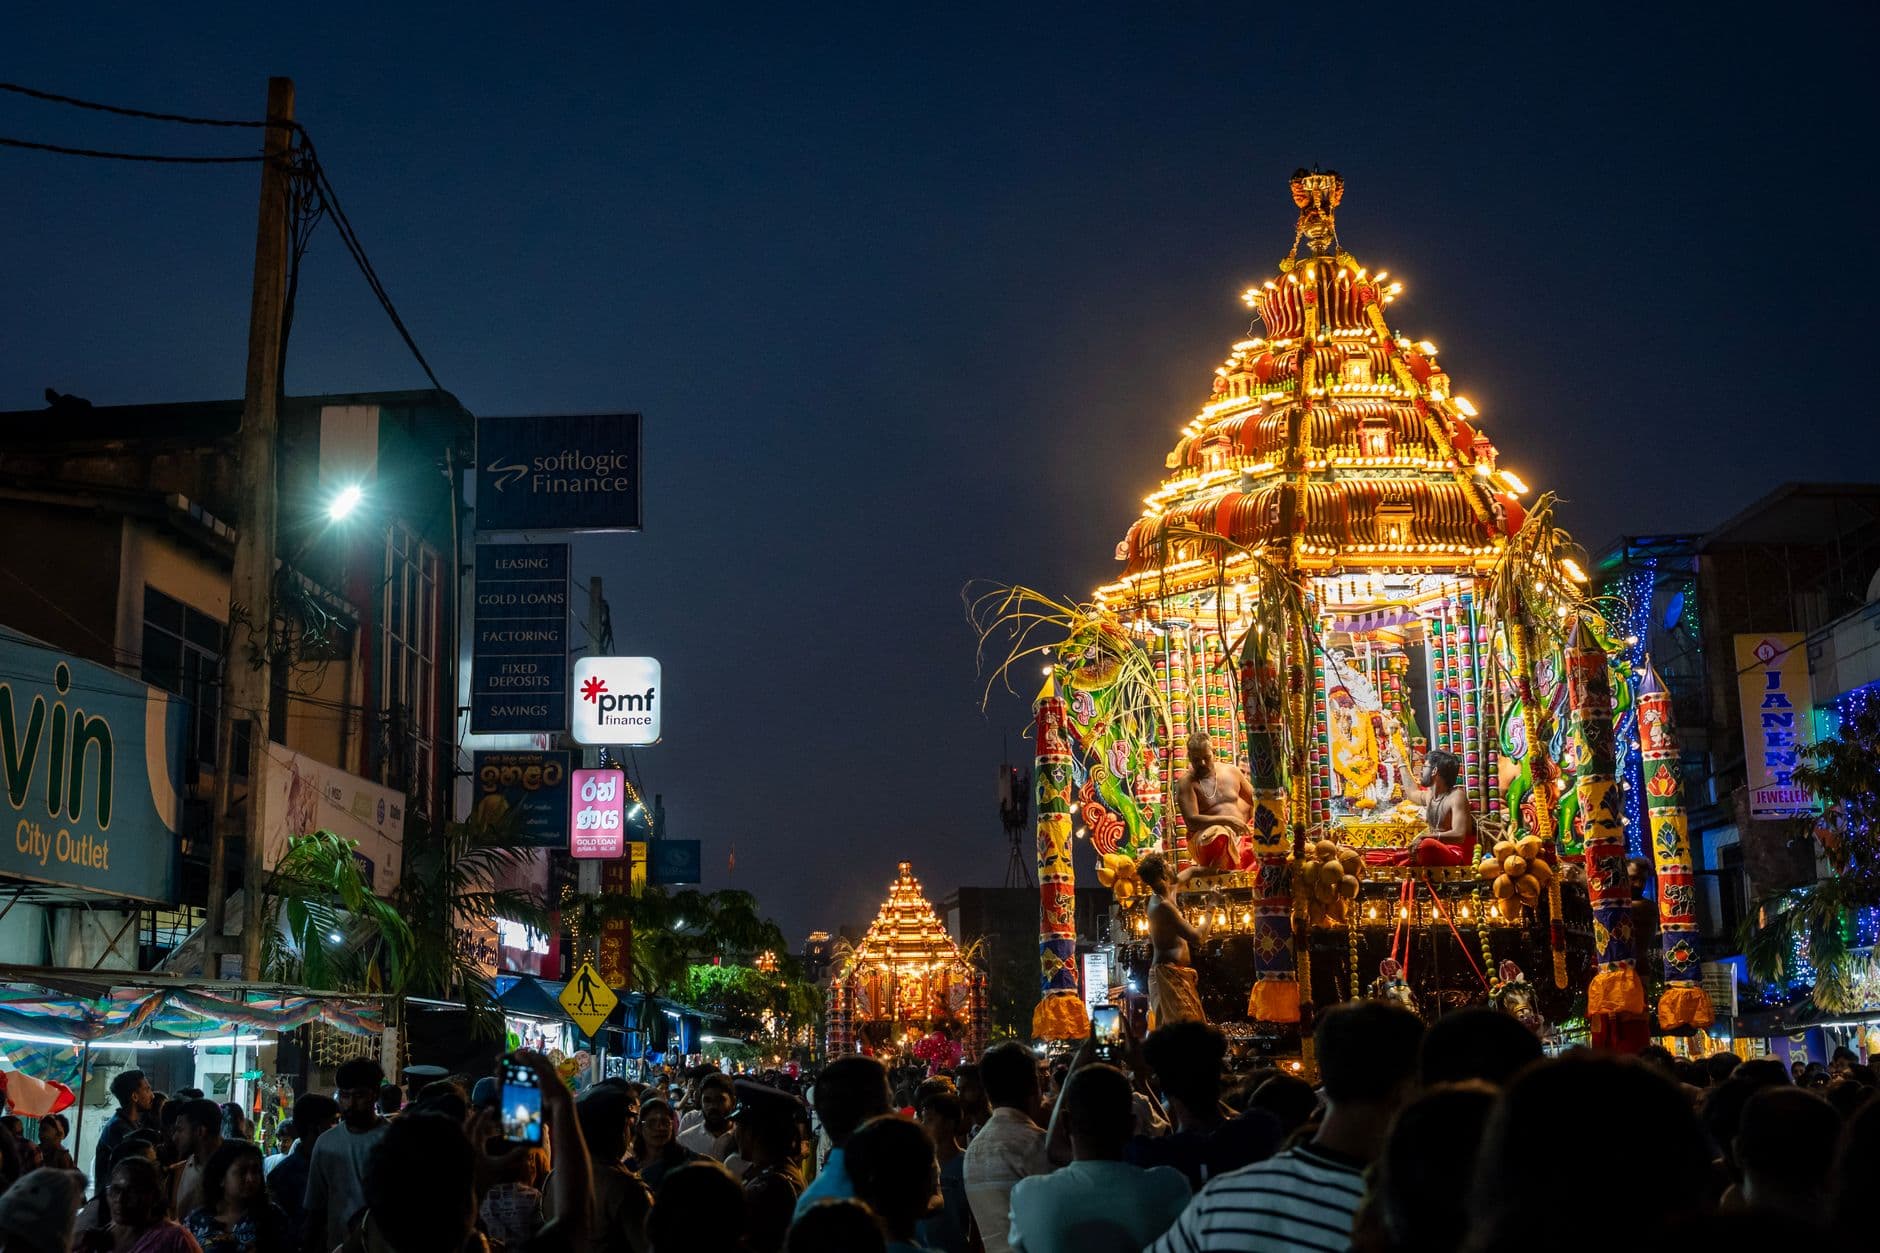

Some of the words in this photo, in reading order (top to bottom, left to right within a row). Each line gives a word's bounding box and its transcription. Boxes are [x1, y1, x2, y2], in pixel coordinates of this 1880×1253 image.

[534, 450, 628, 476] softlogic
[533, 474, 628, 493] Finance
[495, 559, 549, 569] LEASING
[479, 595, 516, 605] GOLD
[520, 593, 564, 604] LOANS
[482, 631, 558, 641] FACTORING
[502, 663, 537, 674] FIXED
[489, 676, 549, 687] DEPOSITS
[491, 705, 548, 716] SAVINGS
[598, 688, 655, 725] pmf
[605, 715, 651, 725] finance
[581, 776, 616, 802] රන්
[576, 805, 619, 830] ණය
[16, 818, 51, 867] City
[55, 828, 109, 870] Outlet
